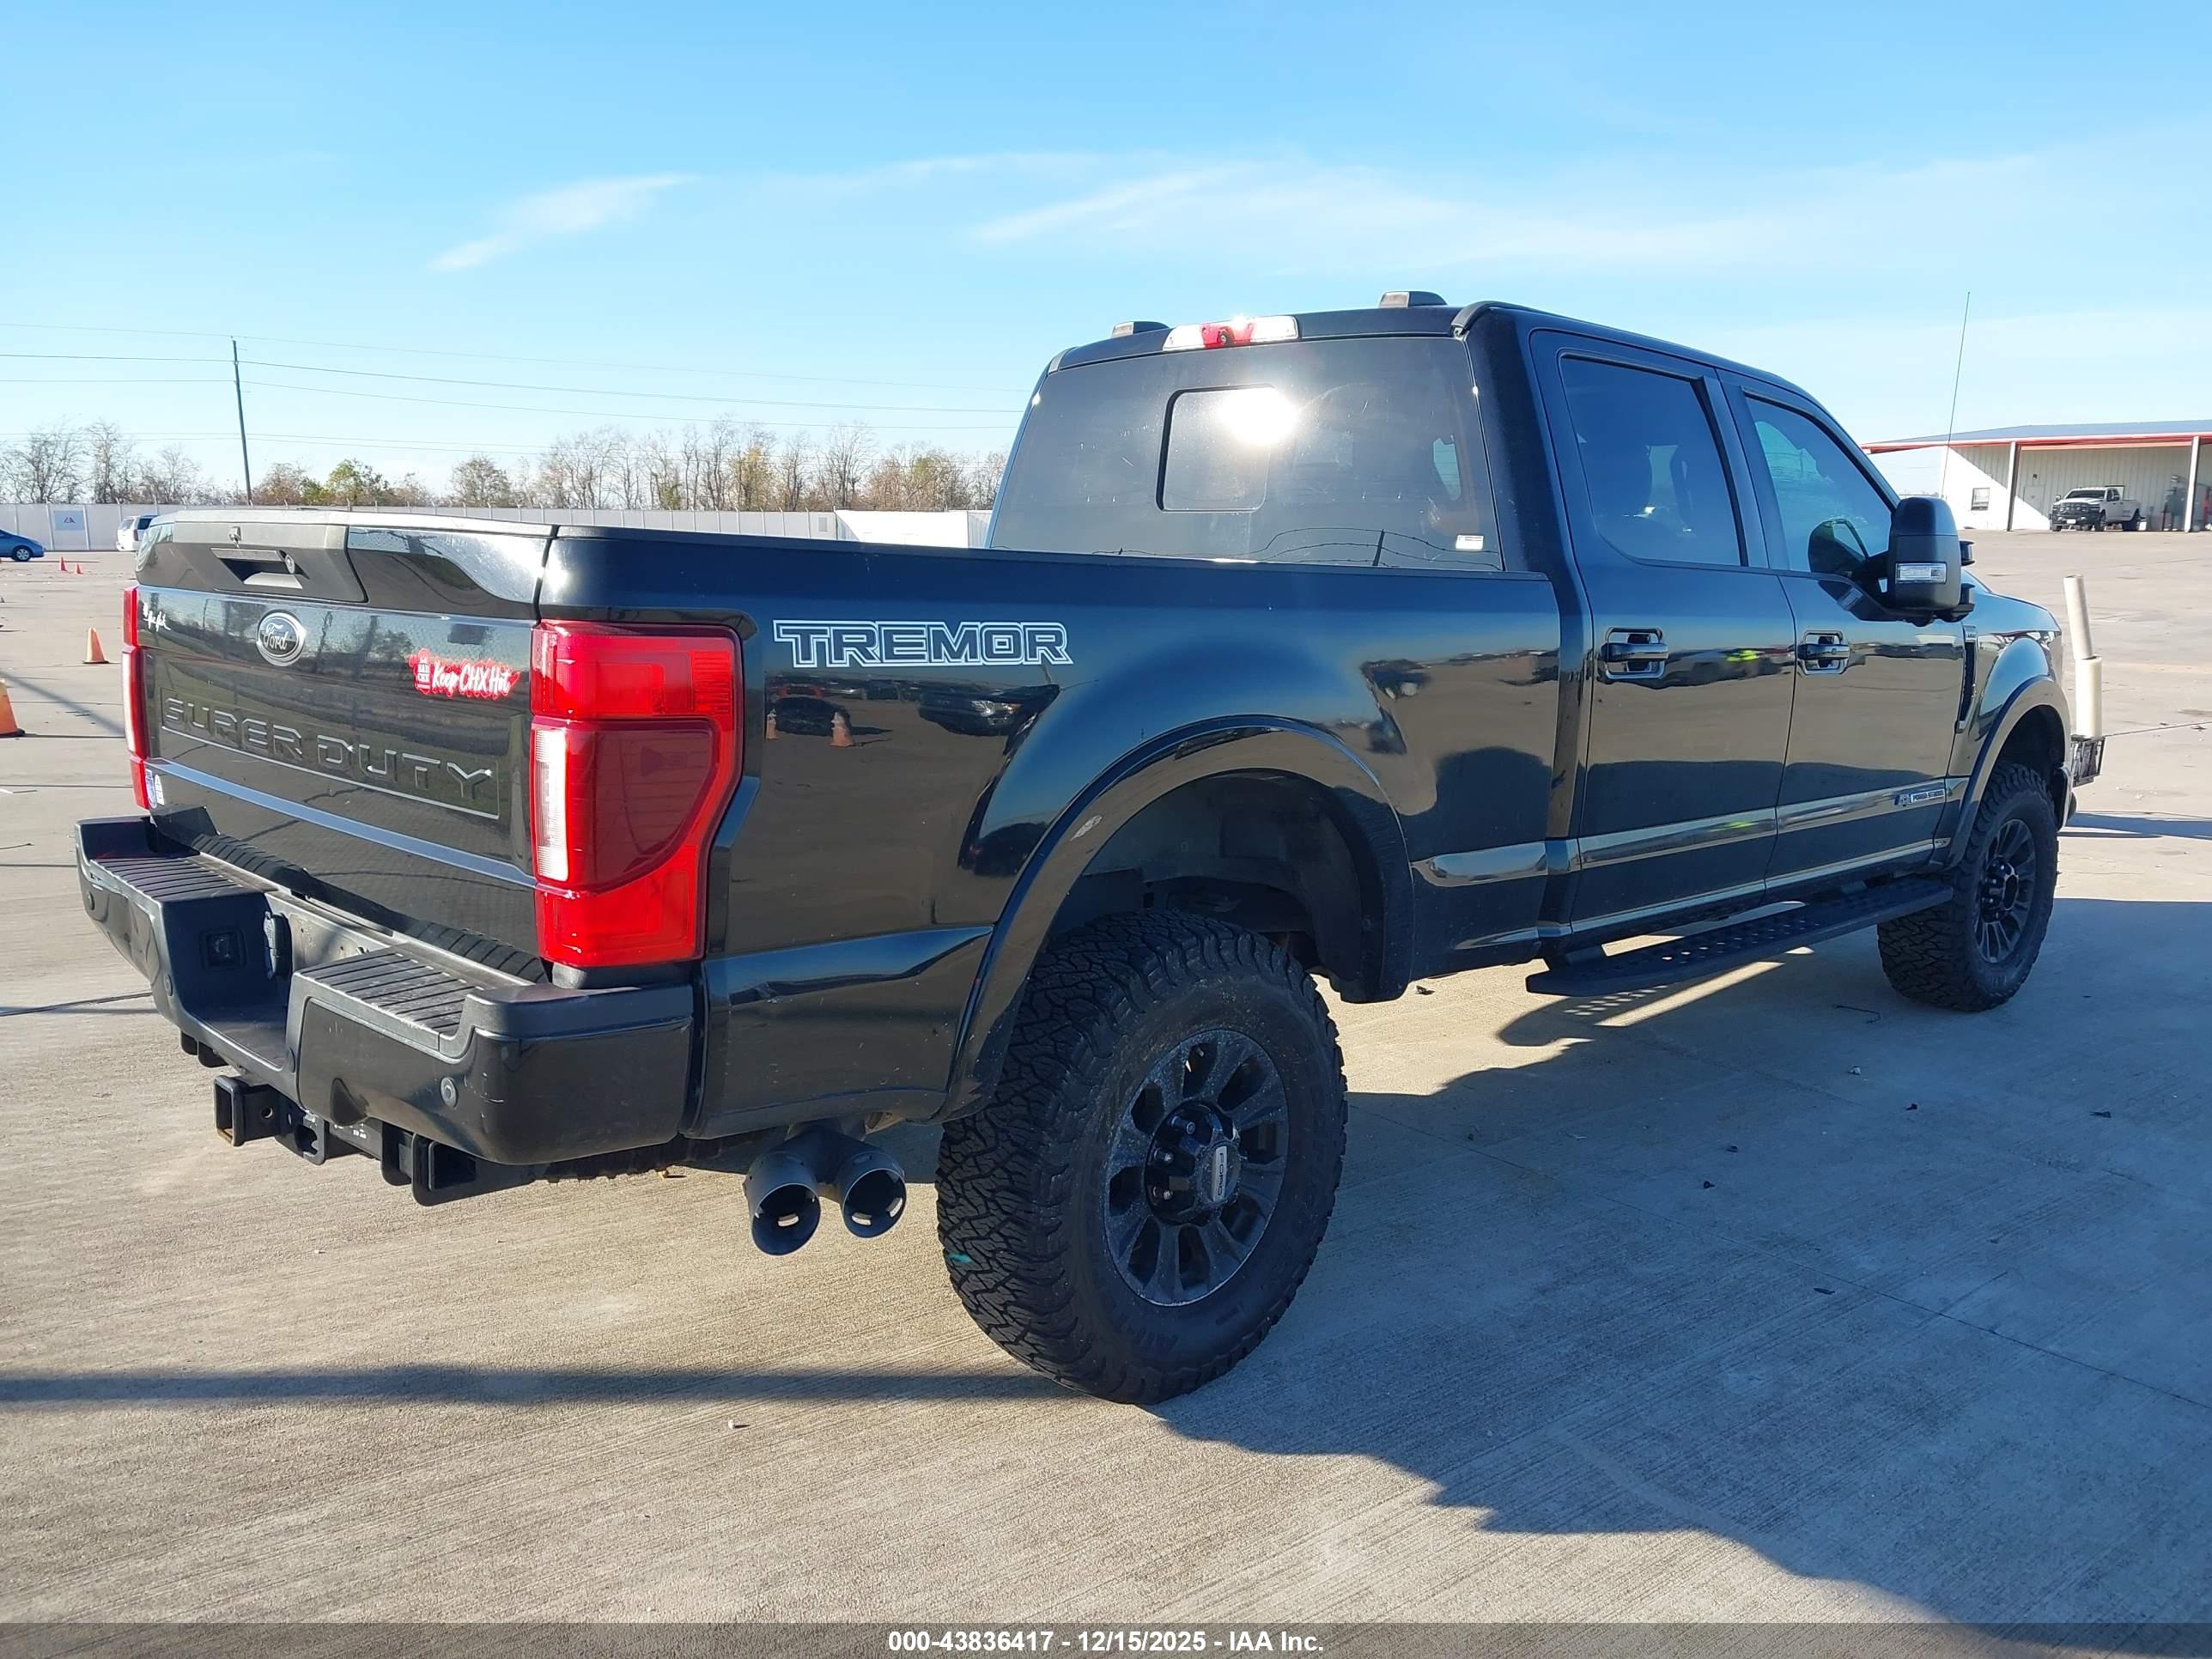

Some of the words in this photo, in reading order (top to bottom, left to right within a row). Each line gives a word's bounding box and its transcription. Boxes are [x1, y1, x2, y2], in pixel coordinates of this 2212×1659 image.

[264, 621, 289, 651] Ford
[773, 619, 1074, 668] TREMOR
[432, 661, 460, 696] Keep
[459, 663, 489, 691] CHX
[489, 665, 512, 696] Hot
[165, 697, 302, 759] SUPER
[317, 734, 493, 799] DUTY
